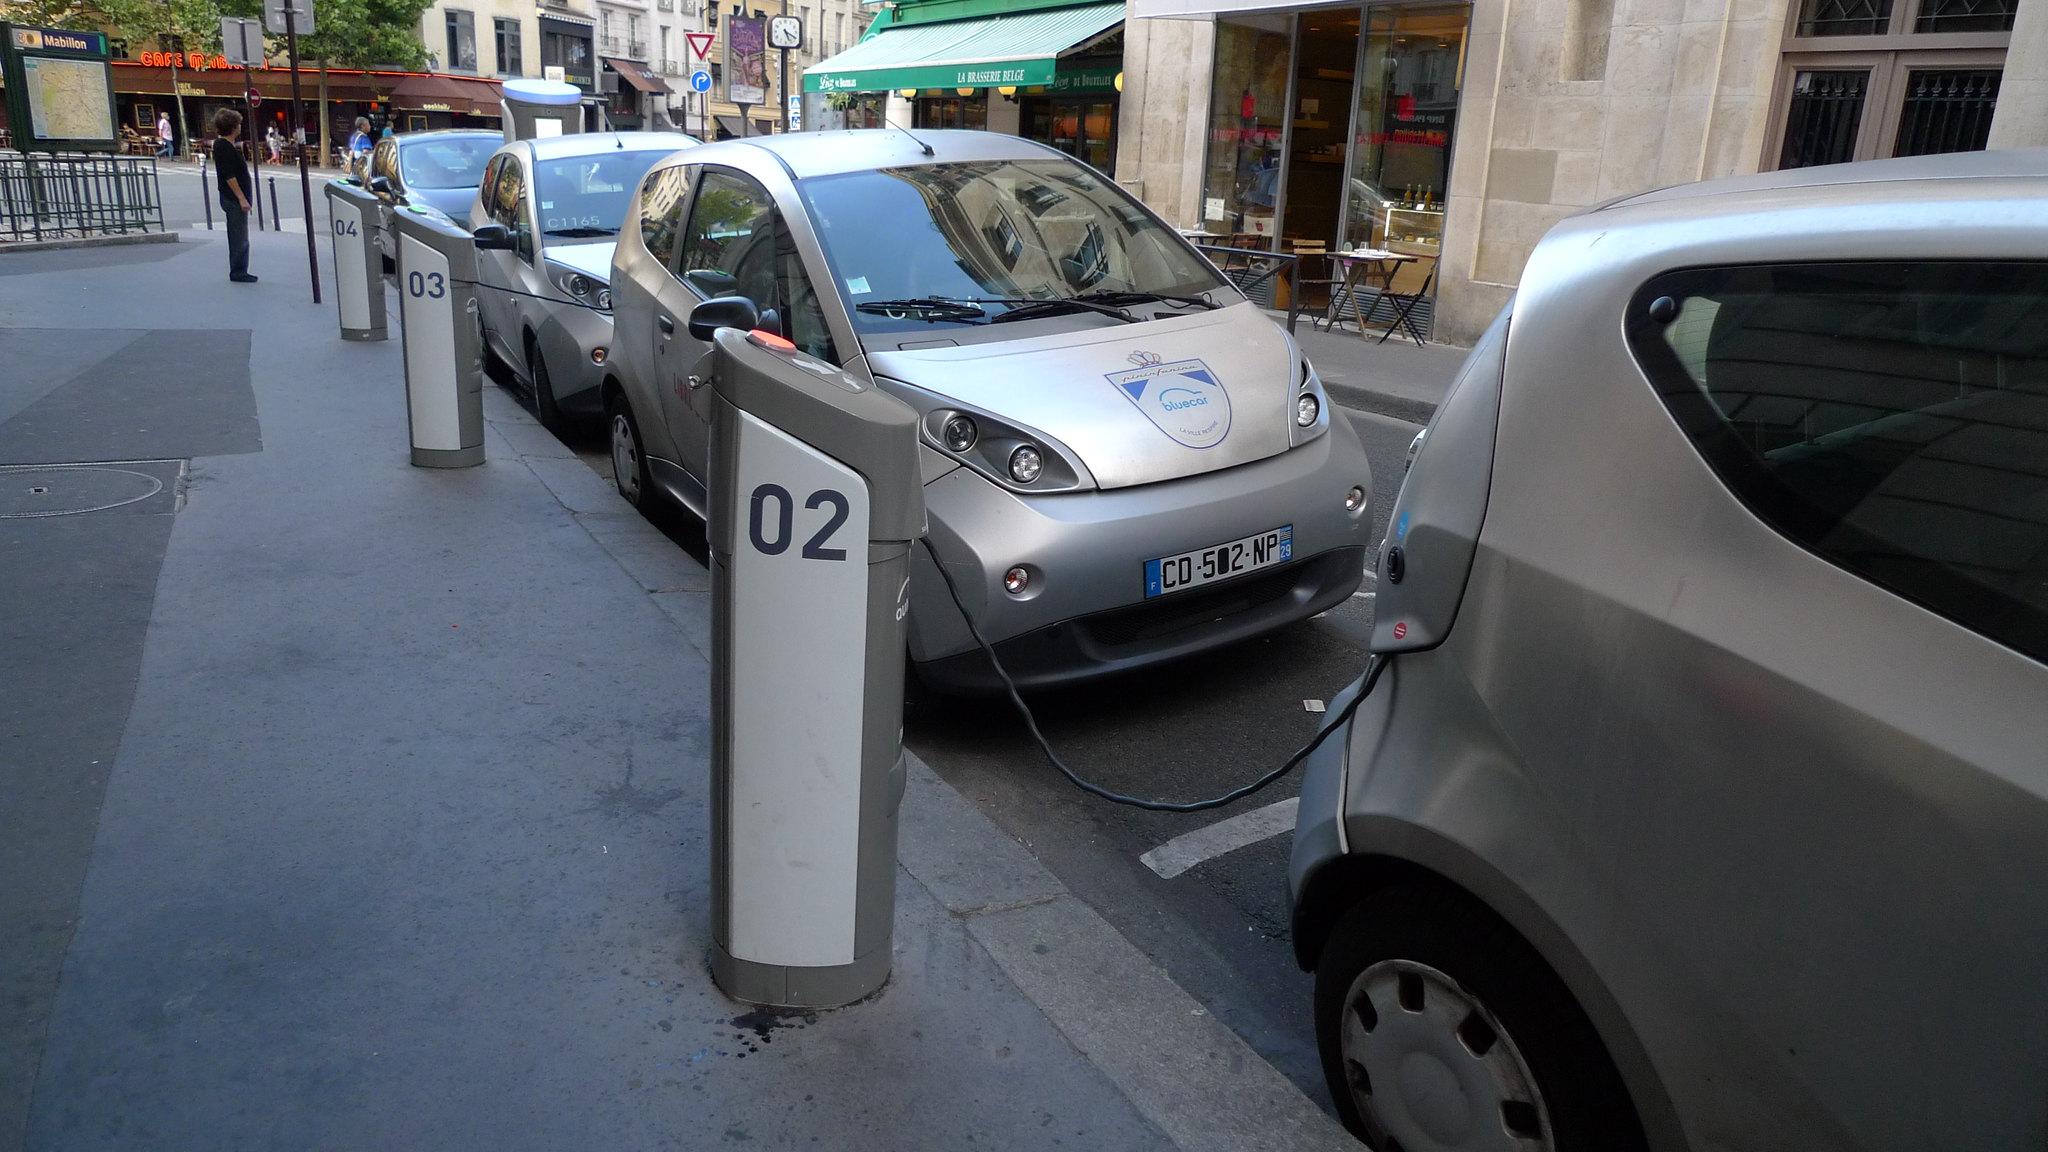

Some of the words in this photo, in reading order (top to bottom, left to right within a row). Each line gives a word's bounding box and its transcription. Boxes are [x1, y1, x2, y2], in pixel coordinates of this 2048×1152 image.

[44, 35, 87, 50] Mabillon
[957, 72, 966, 83] LA
[967, 70, 1001, 83] BRASSERIE
[1002, 69, 1025, 82] BELGE
[335, 219, 358, 237] 04
[547, 216, 600, 228] C1165
[409, 271, 445, 299] 03
[1161, 396, 1209, 412] bluecar
[1187, 428, 1202, 436] VILLE
[749, 483, 850, 562] 02
[1281, 543, 1292, 559] 29
[1150, 581, 1157, 591] F
